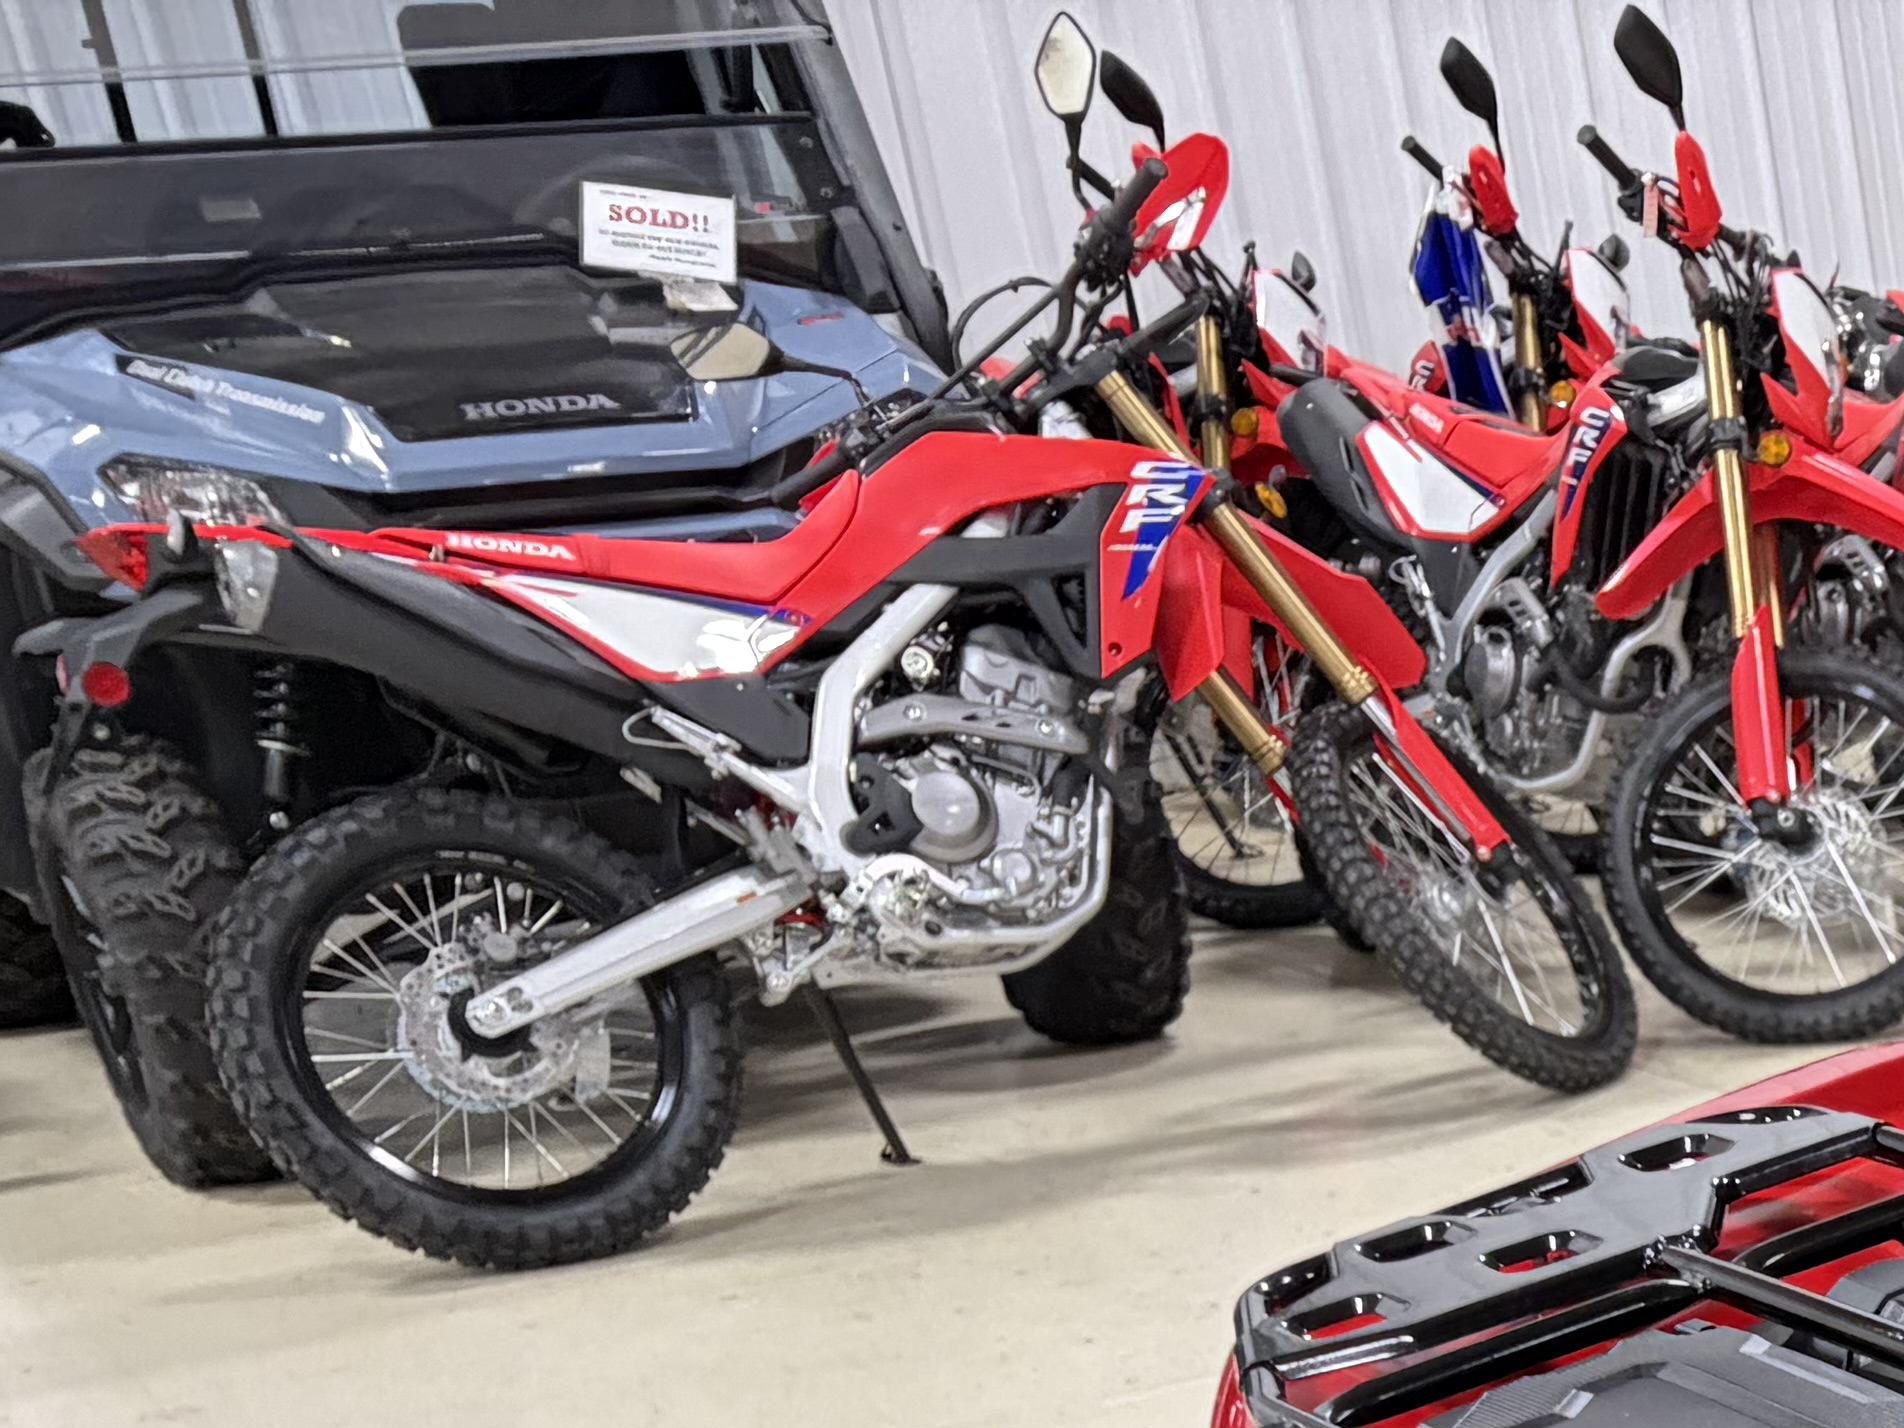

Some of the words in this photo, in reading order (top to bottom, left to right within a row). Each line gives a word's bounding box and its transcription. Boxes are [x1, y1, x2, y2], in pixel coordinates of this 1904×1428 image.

[609, 204, 709, 232] SOLD!!
[1408, 360, 1434, 391] CR
[460, 393, 621, 420] HONDA
[1119, 461, 1206, 533] CRF
[445, 533, 576, 561] HONDA
